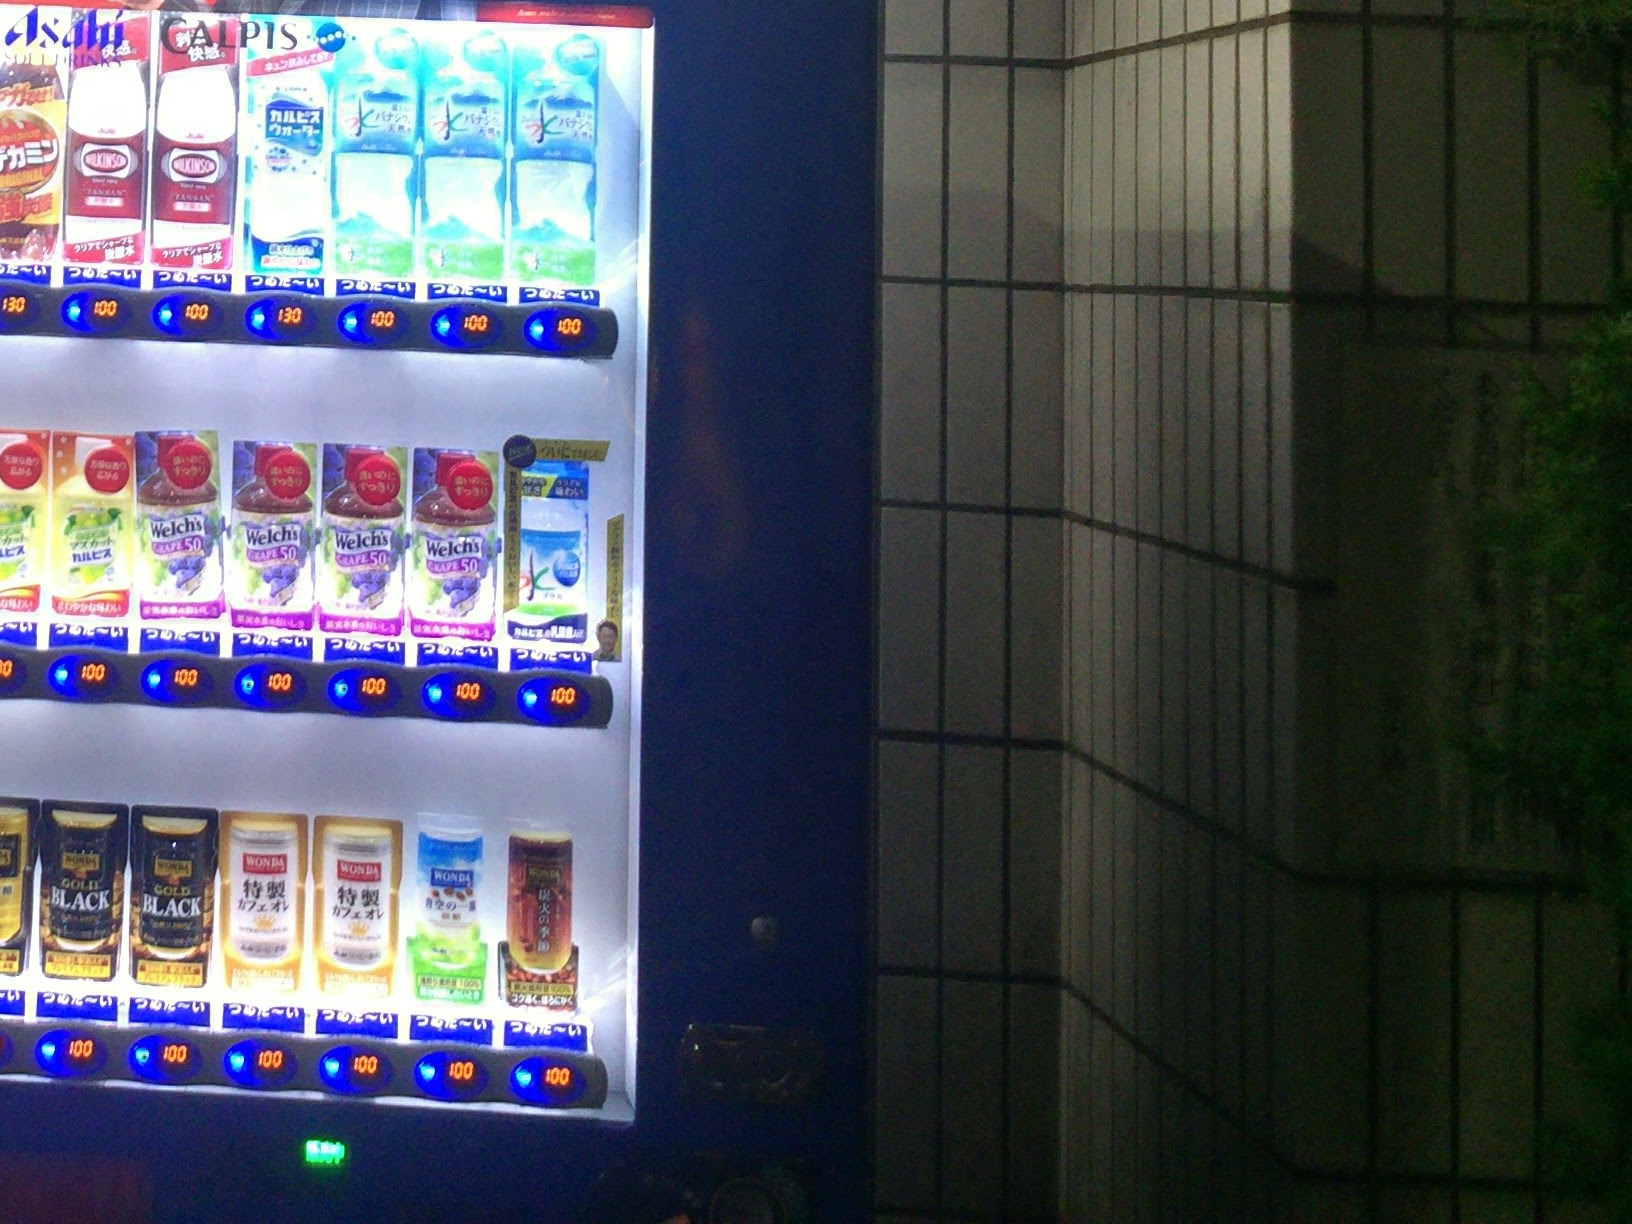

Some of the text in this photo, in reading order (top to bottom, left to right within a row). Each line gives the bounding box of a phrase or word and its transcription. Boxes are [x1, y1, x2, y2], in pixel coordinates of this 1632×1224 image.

[4, 5, 125, 50] Asahi
[160, 17, 299, 54] CALPIS
[269, 109, 321, 124] カルピス
[269, 124, 321, 137] ウォーター
[84, 150, 128, 170] WILKINSON
[173, 156, 217, 175] WILKINSON
[2, 296, 26, 313] 130
[93, 300, 118, 317] 100
[184, 304, 209, 320] 100
[278, 308, 302, 324] 130
[370, 311, 395, 327] 100
[463, 315, 488, 331] 100
[557, 318, 582, 335] 100
[150, 517, 204, 539] Welch's
[245, 525, 299, 547] Welch's
[184, 536, 203, 553] 50
[334, 530, 390, 551] Welch's
[426, 536, 481, 558] Welch's
[71, 547, 113, 563] カルピス
[279, 545, 298, 561] 50
[369, 550, 388, 566] 50
[460, 556, 478, 573] 50
[80, 663, 106, 681] 100
[173, 669, 198, 686] 100
[267, 673, 292, 691] 100
[361, 677, 386, 695] 100
[455, 683, 480, 700] 100
[550, 687, 576, 705] 100
[245, 855, 286, 872] WONDA
[340, 862, 380, 879] WONDA
[433, 869, 474, 885] WONDA
[50, 885, 111, 911] BLACK
[242, 879, 286, 899] 特製
[337, 886, 381, 906] 特製
[142, 892, 203, 919] BLACK
[237, 897, 290, 914] カフェオレ
[331, 905, 385, 921] カフェオレ
[68, 1040, 93, 1058] 100
[162, 1045, 188, 1063] 100
[257, 1051, 283, 1069] 100
[352, 1055, 378, 1074] 100
[448, 1061, 474, 1080] 100
[544, 1067, 570, 1086] 100
